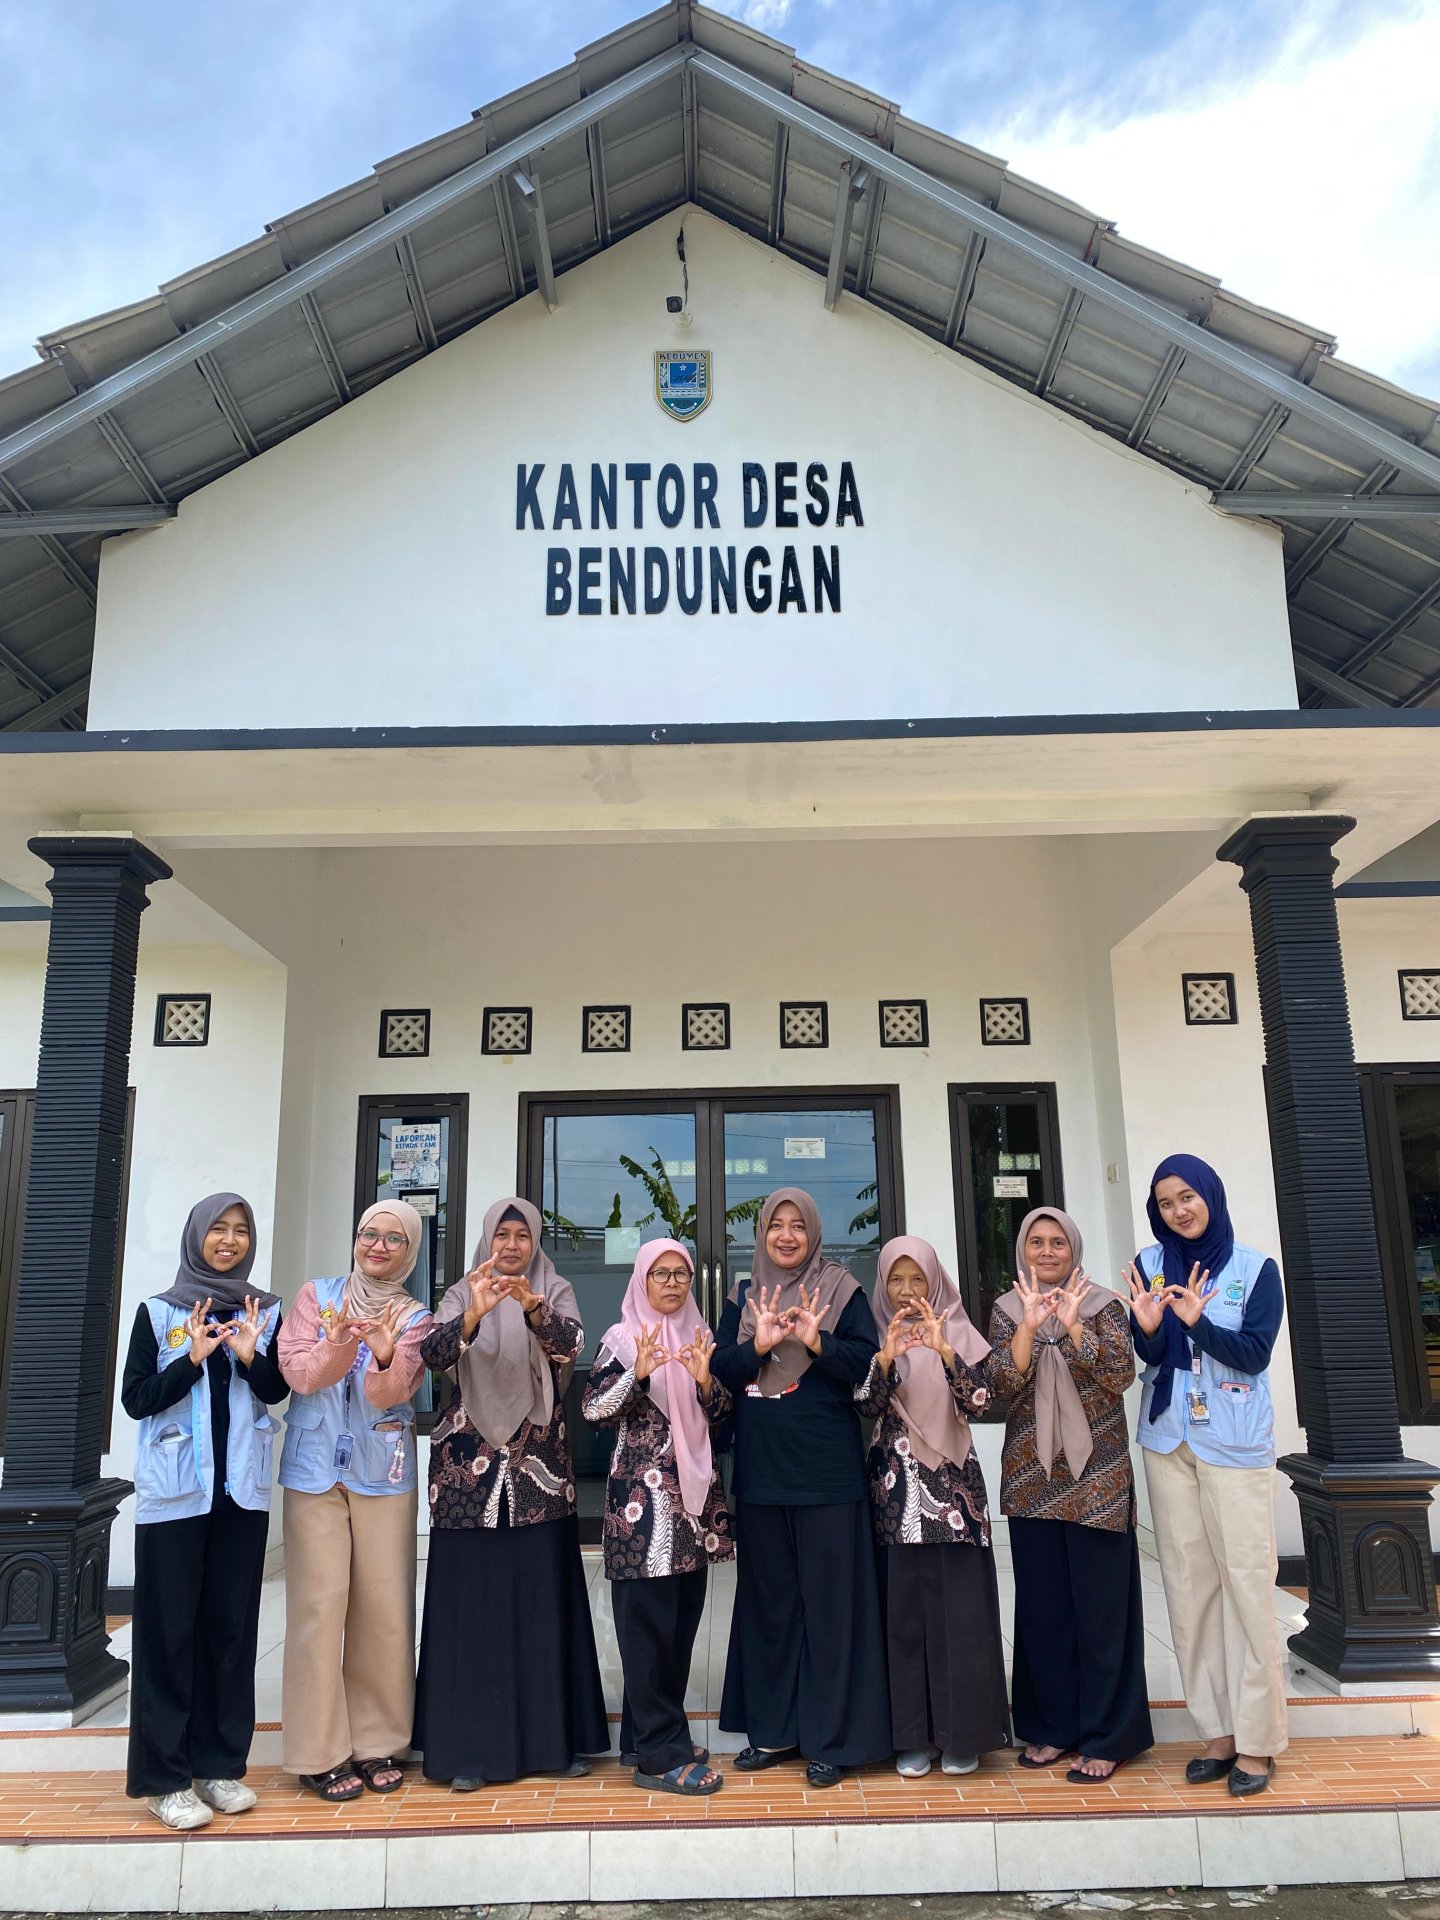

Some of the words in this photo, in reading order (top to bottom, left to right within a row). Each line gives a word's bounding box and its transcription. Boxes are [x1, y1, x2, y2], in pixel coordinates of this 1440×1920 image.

[659, 352, 707, 360] KEBUMEN
[515, 462, 722, 531] KANTOR
[742, 460, 865, 529] DESA
[545, 544, 842, 616] BENDUNGAN
